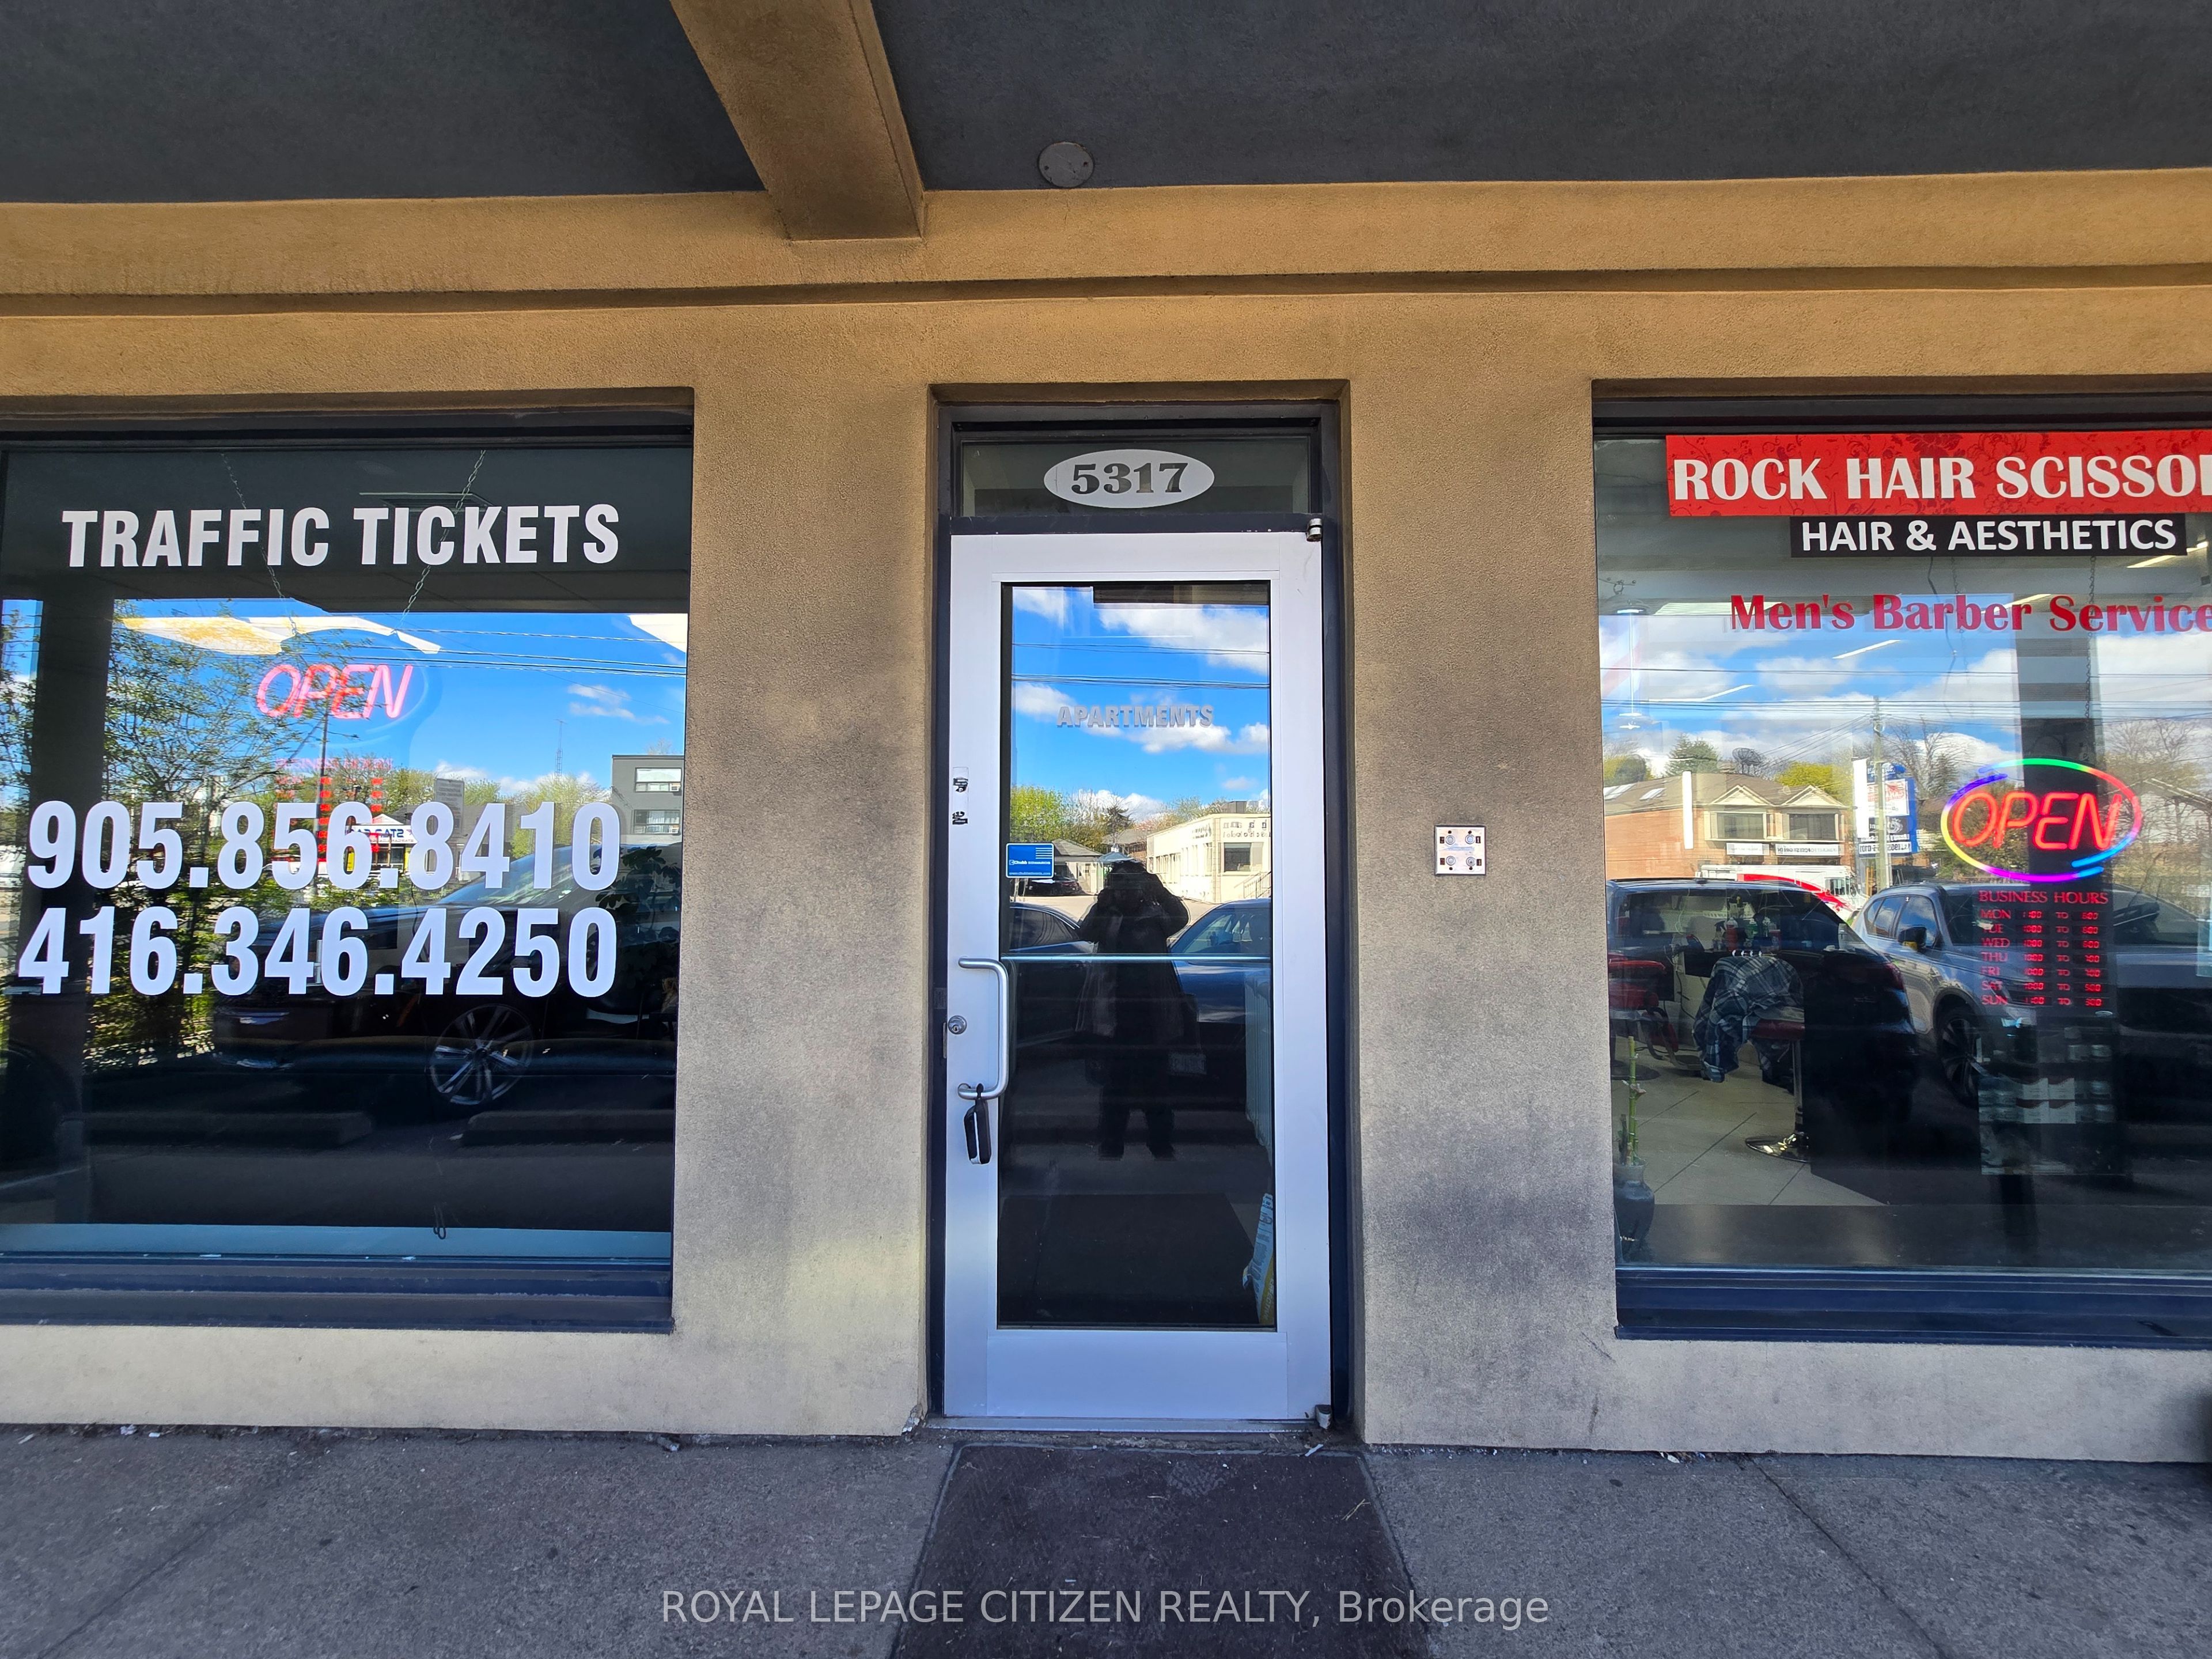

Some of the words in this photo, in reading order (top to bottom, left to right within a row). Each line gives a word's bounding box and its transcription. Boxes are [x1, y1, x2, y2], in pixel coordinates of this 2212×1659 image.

[1071, 462, 1188, 495] 5317
[1674, 458, 1827, 500] ROCK
[1846, 457, 1976, 499] HAIR
[62, 507, 329, 567] TRAFFIC
[353, 503, 619, 565] TICKETS
[1802, 521, 1895, 551] HAIR
[1906, 520, 1937, 551] &
[1948, 519, 2176, 550] AESTHETICS
[1731, 594, 1855, 630] Men's
[1874, 593, 2033, 631] Barber
[255, 664, 414, 719] OPEN
[1056, 704, 1214, 728] APARTMENTS
[1952, 791, 2122, 851] OPEN
[28, 800, 620, 891] 905.856.8410
[1979, 890, 2048, 903] BUSINESS
[2054, 892, 2109, 904] HOURS
[1980, 909, 2011, 920] MON
[17, 905, 617, 998] 416.346.4250
[1981, 952, 2008, 962] THU
[1982, 938, 2010, 948] WED
[1981, 967, 2001, 976] FRI
[1981, 981, 2003, 991] SAT
[1981, 995, 2008, 1005] SUN
